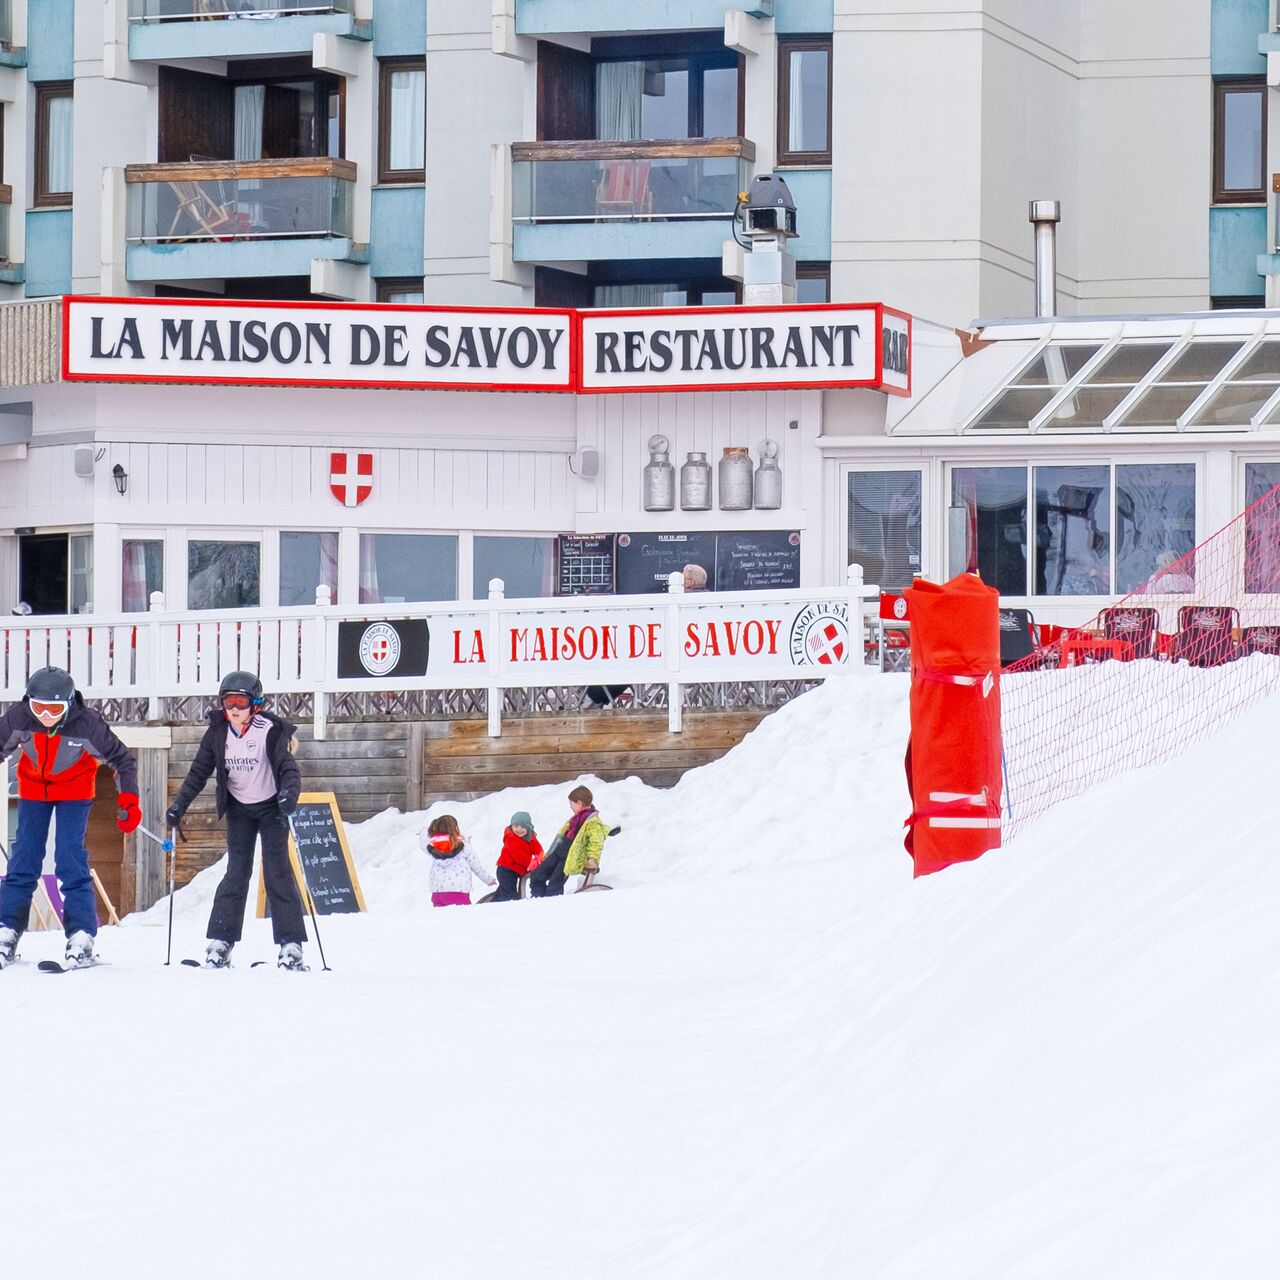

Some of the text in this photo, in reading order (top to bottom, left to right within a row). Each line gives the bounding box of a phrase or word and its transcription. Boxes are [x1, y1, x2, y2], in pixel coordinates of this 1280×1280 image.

[89, 316, 565, 370] LA MAISON DE SAVOY
[594, 323, 861, 374] RESTAURANT
[883, 327, 908, 375] BAR
[452, 619, 783, 663] LA MAISON DE SAVOY
[224, 755, 259, 765] mirates
